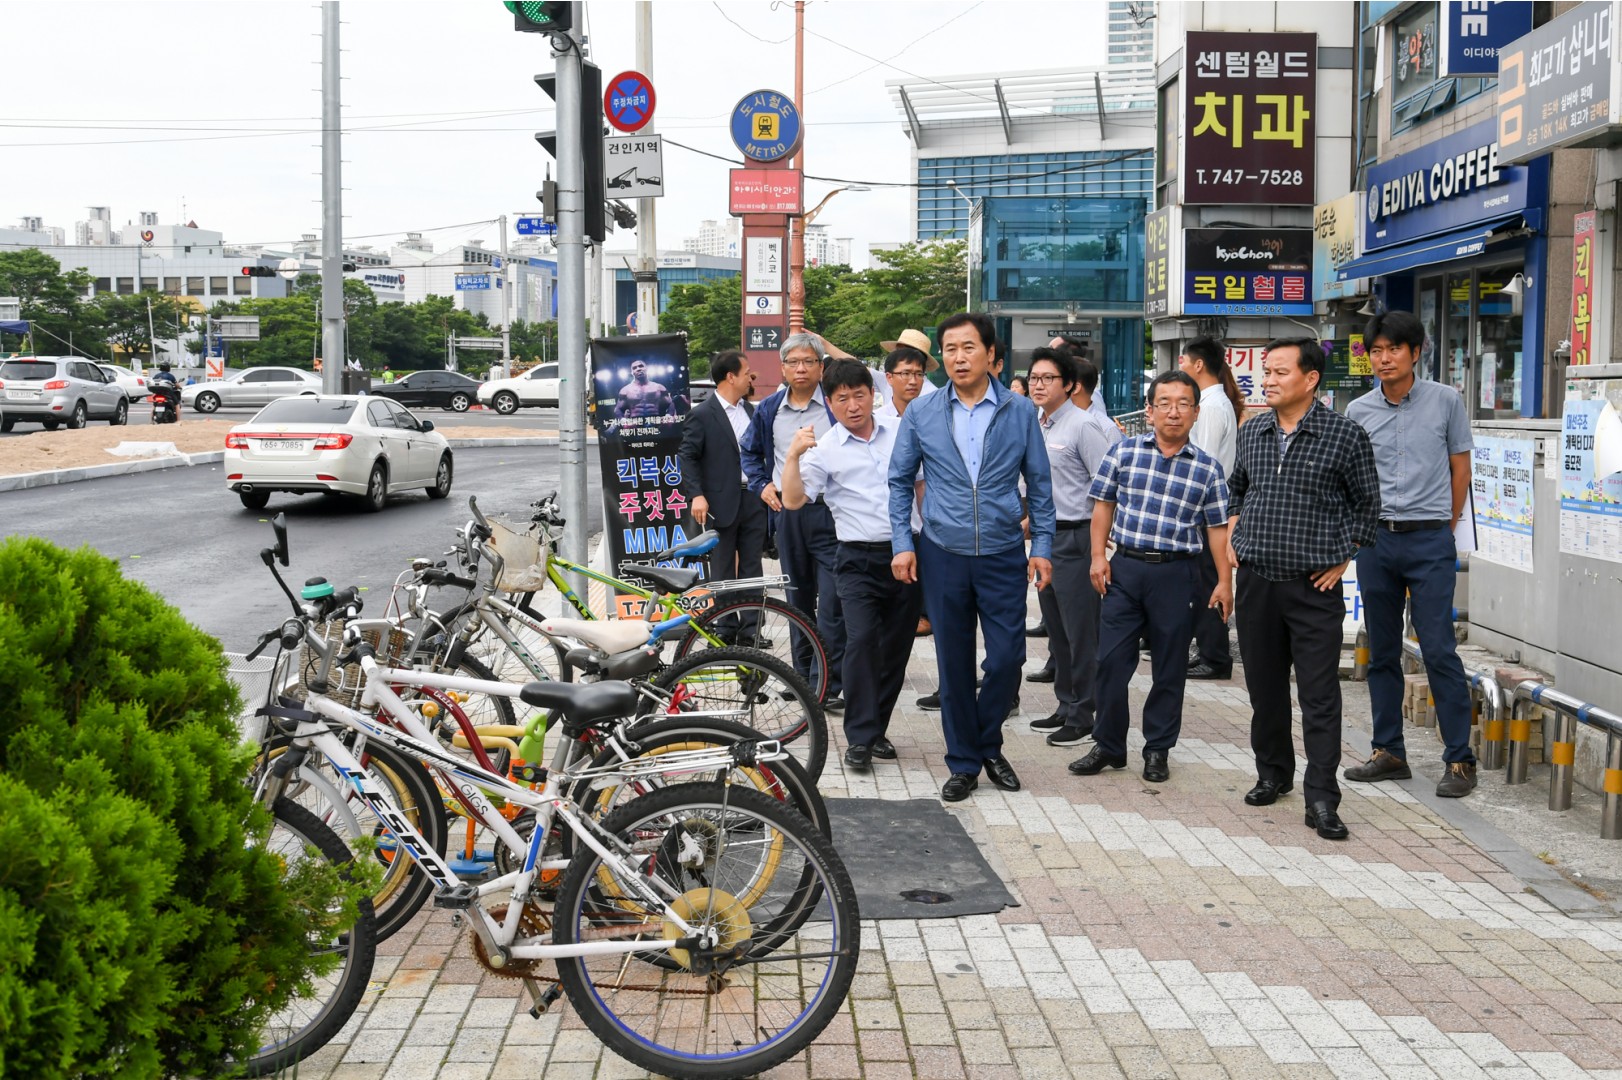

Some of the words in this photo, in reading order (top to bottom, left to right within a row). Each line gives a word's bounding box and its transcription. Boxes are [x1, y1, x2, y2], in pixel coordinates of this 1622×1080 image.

[1529, 36, 1567, 88] 최고가
[1569, 4, 1613, 76] 삽니다
[1195, 50, 1309, 78] 센텀월드
[613, 95, 646, 109] 주정차금지
[740, 94, 793, 119] 도시철도
[1498, 50, 1526, 148] 금
[1580, 83, 1594, 104] 판매
[1193, 91, 1310, 148] 치과
[1540, 121, 1553, 140] 18K
[1555, 116, 1568, 134] 14K
[1570, 107, 1589, 127] 최고가
[608, 141, 658, 155] 견인지역
[744, 142, 786, 158] METRO
[1382, 169, 1426, 217] EDIYA
[1429, 142, 1500, 202] COFFEE
[1148, 214, 1167, 253] 야간
[768, 243, 777, 274] 벡스코
[1216, 245, 1274, 262] KyoChon
[1148, 258, 1166, 295] 진료
[1566, 414, 1588, 430] 대선주조
[1565, 434, 1582, 451] 캐릭터
[1583, 434, 1595, 451] 디자
[616, 454, 683, 488] 킥복싱
[1564, 455, 1582, 471] 공모전
[618, 488, 688, 523] 주짓수
[623, 524, 690, 555] MMA
[460, 783, 488, 816] GIGS
